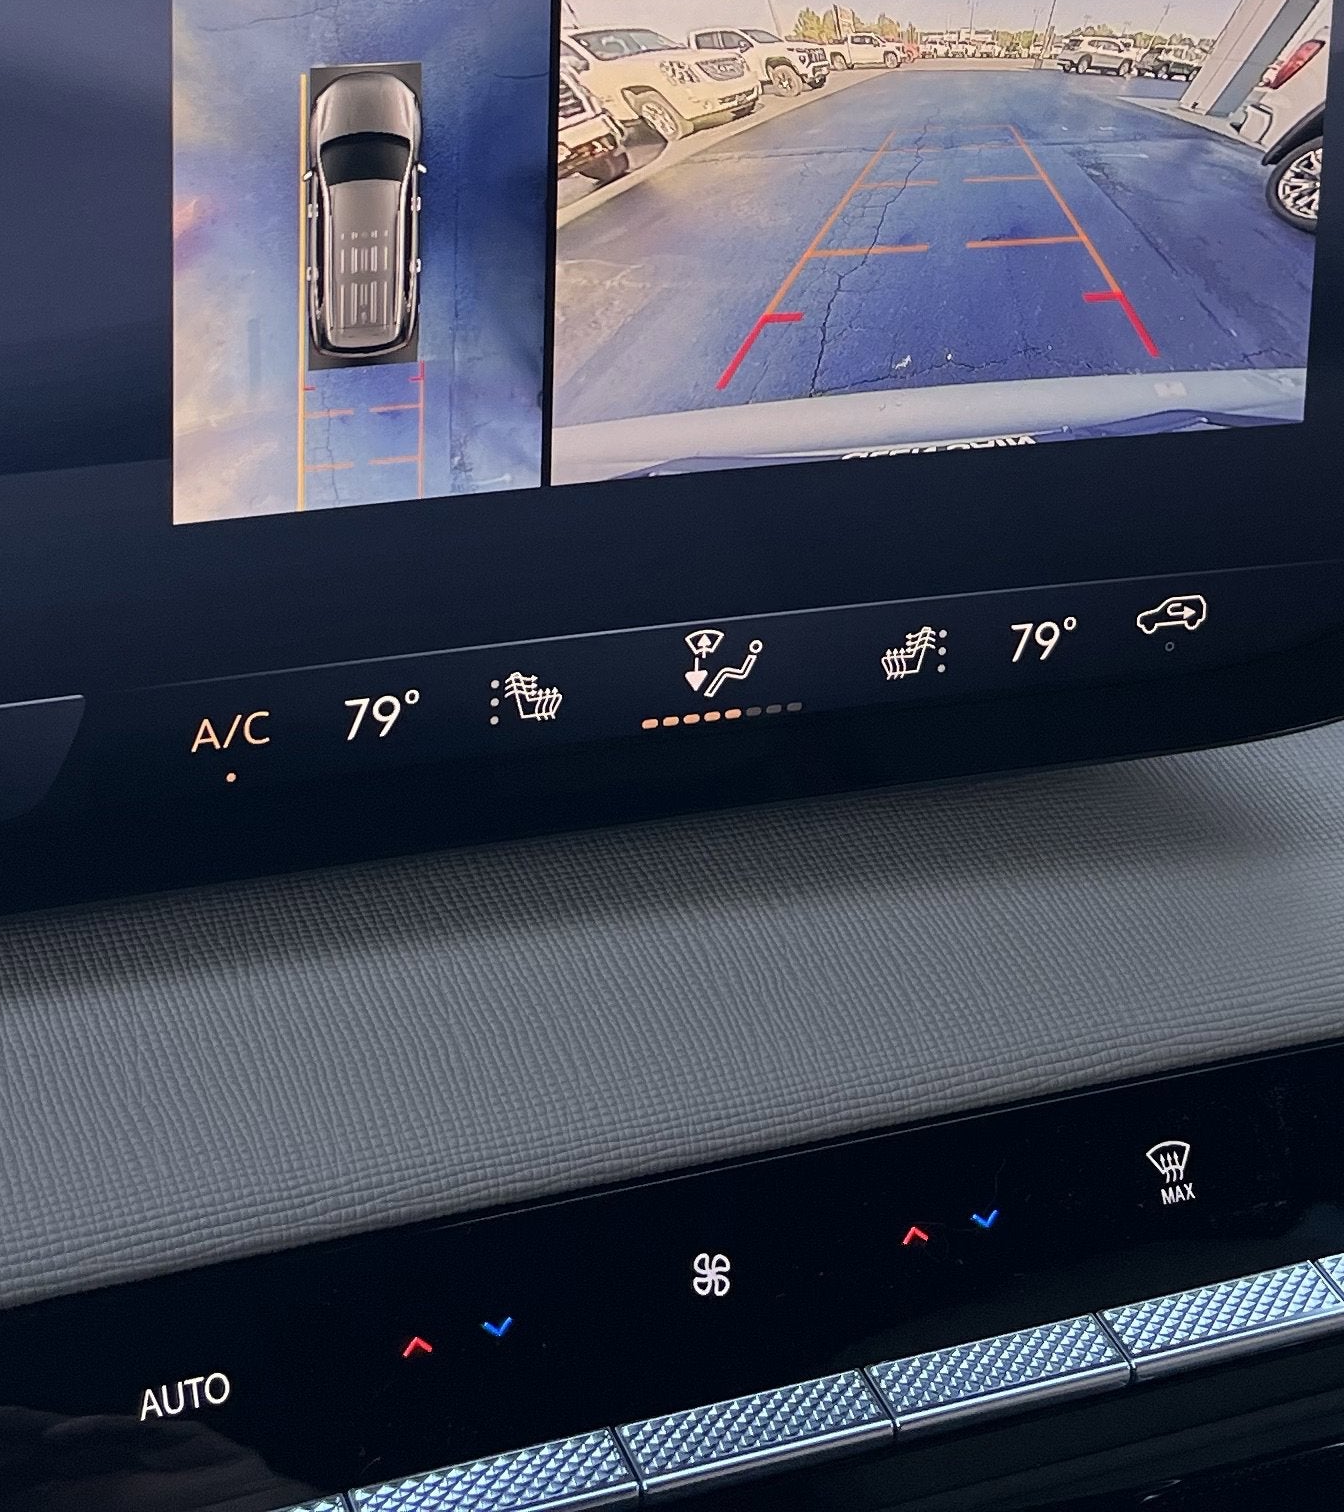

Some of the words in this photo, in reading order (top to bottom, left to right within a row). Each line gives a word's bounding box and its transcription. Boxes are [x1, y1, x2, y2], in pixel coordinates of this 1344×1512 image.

[190, 710, 271, 754] A/C
[1159, 1182, 1197, 1206] MAX
[139, 1372, 231, 1422] AUTO
